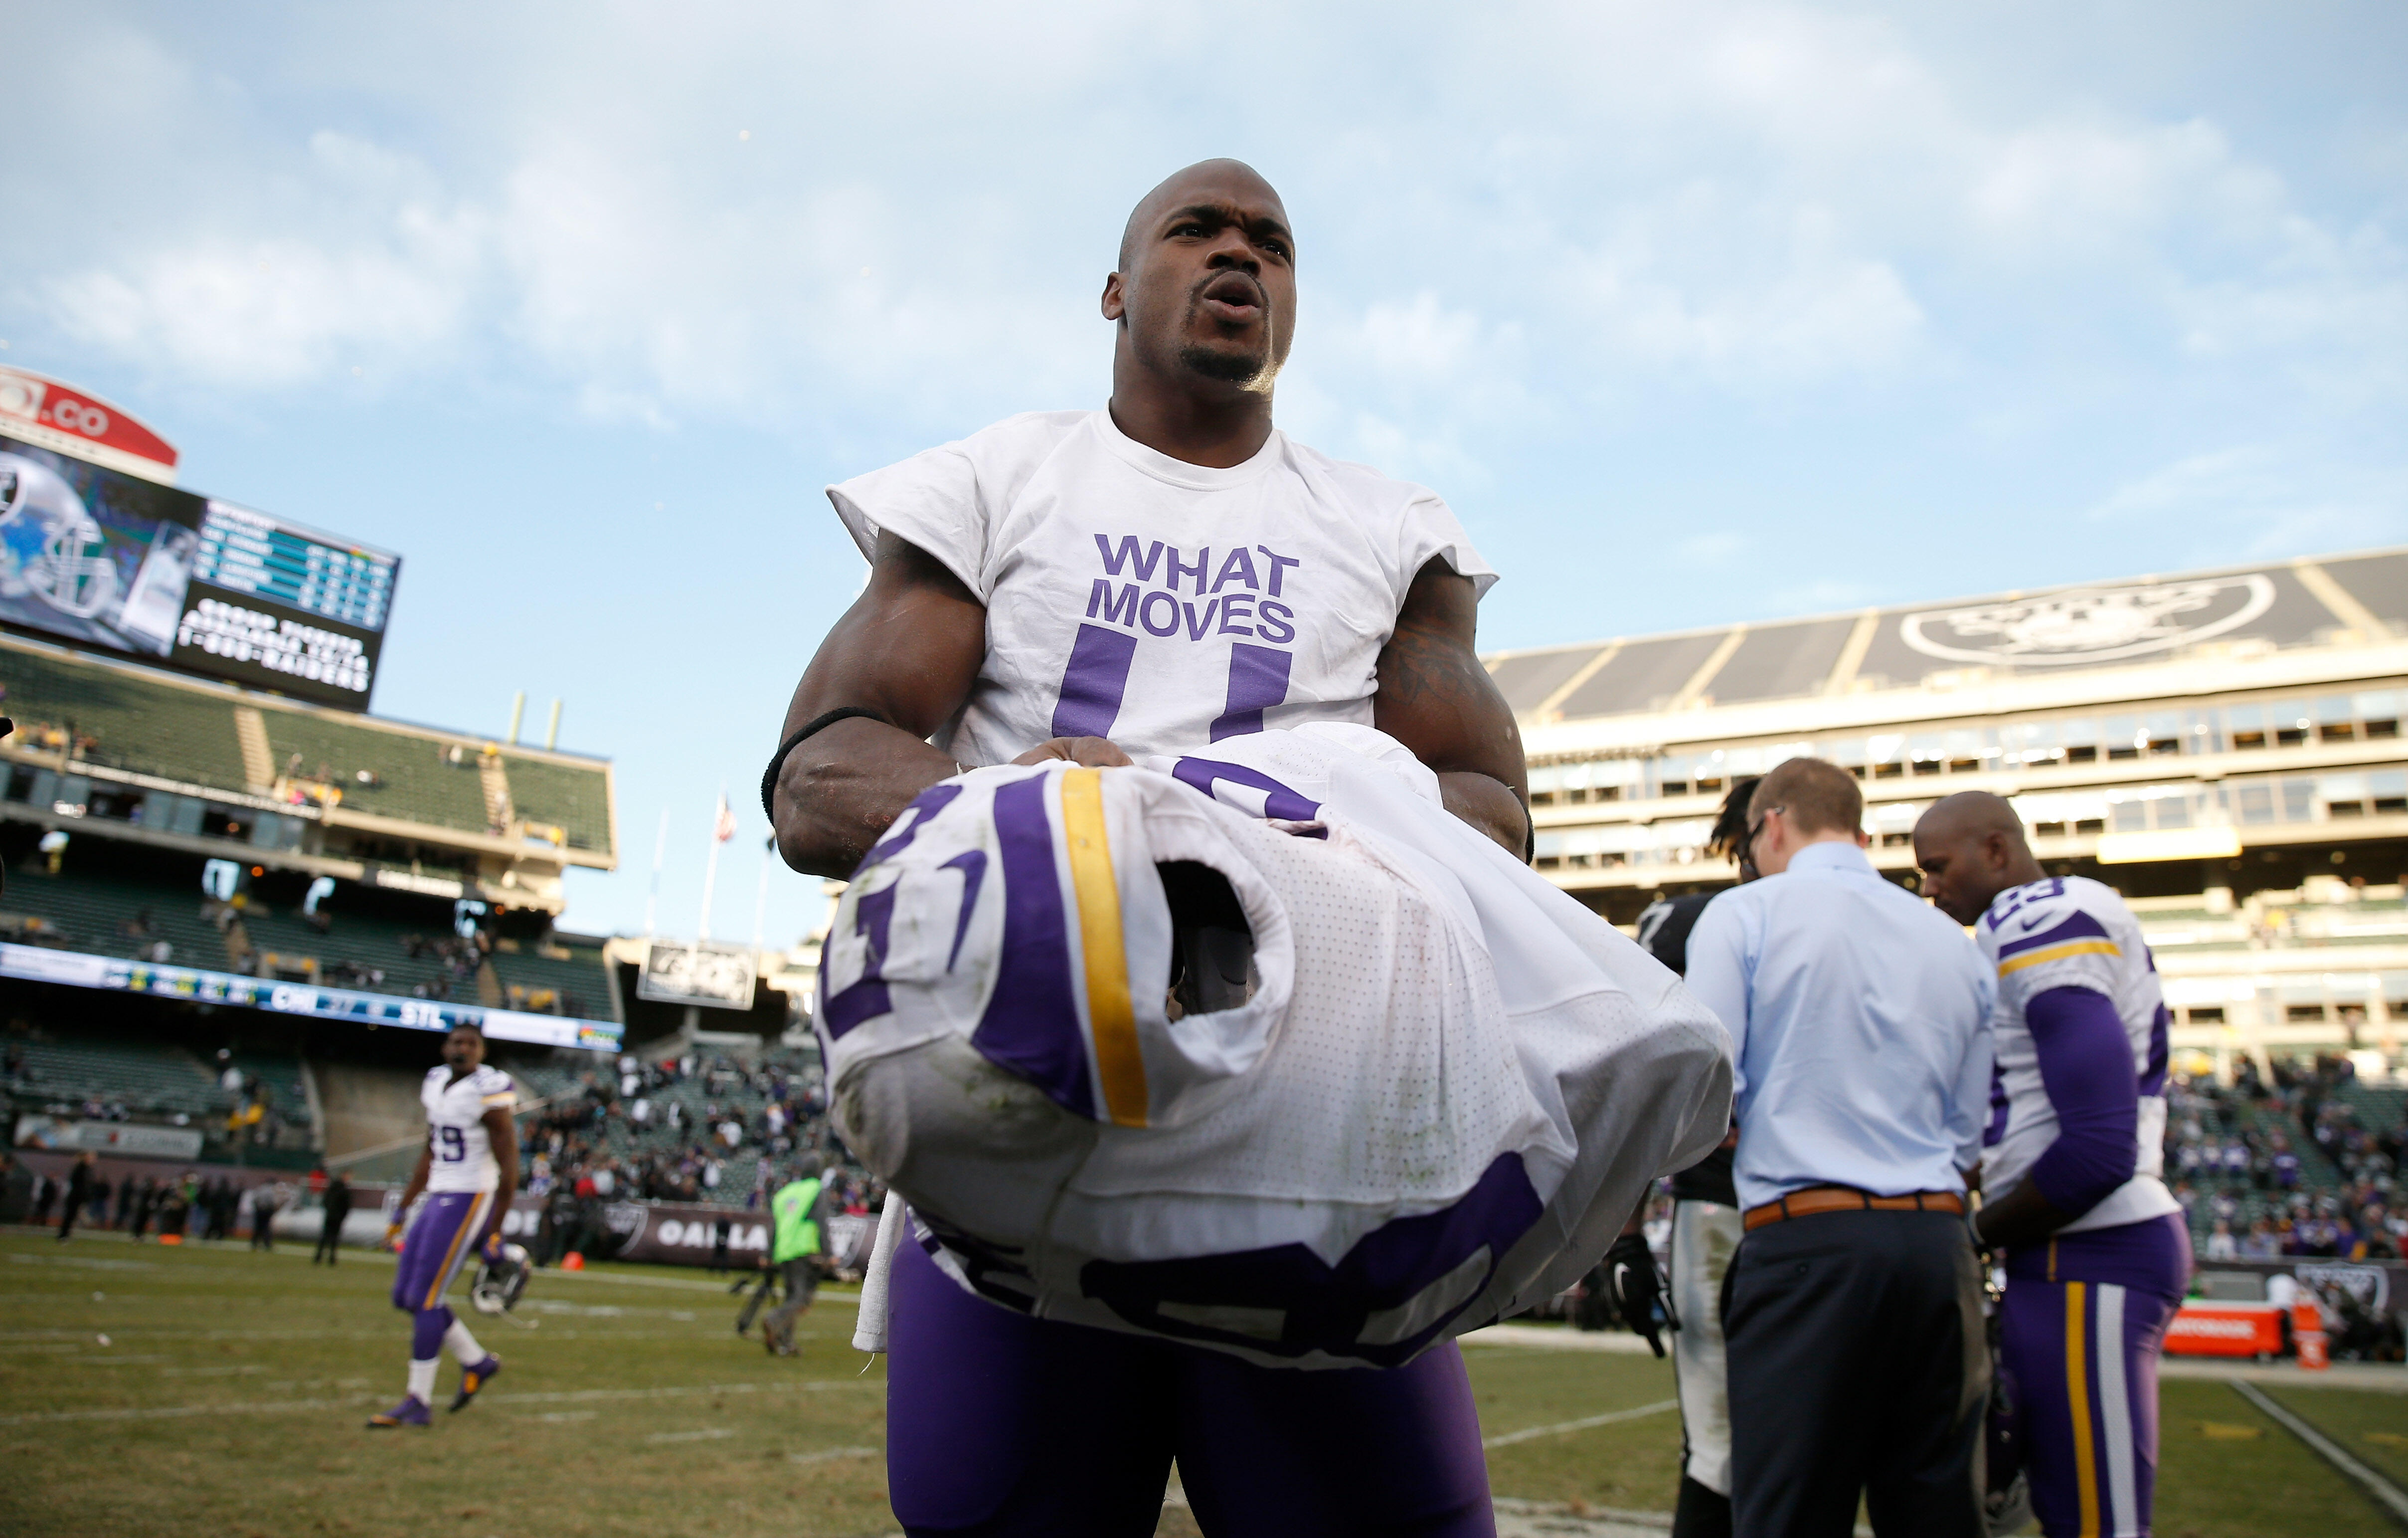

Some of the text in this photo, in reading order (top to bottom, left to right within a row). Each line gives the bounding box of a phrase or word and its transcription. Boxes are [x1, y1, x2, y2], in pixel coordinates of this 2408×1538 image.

[1094, 534, 1299, 597] WHAT
[1085, 578, 1295, 643] MOVES
[399, 1001, 447, 1030] STL
